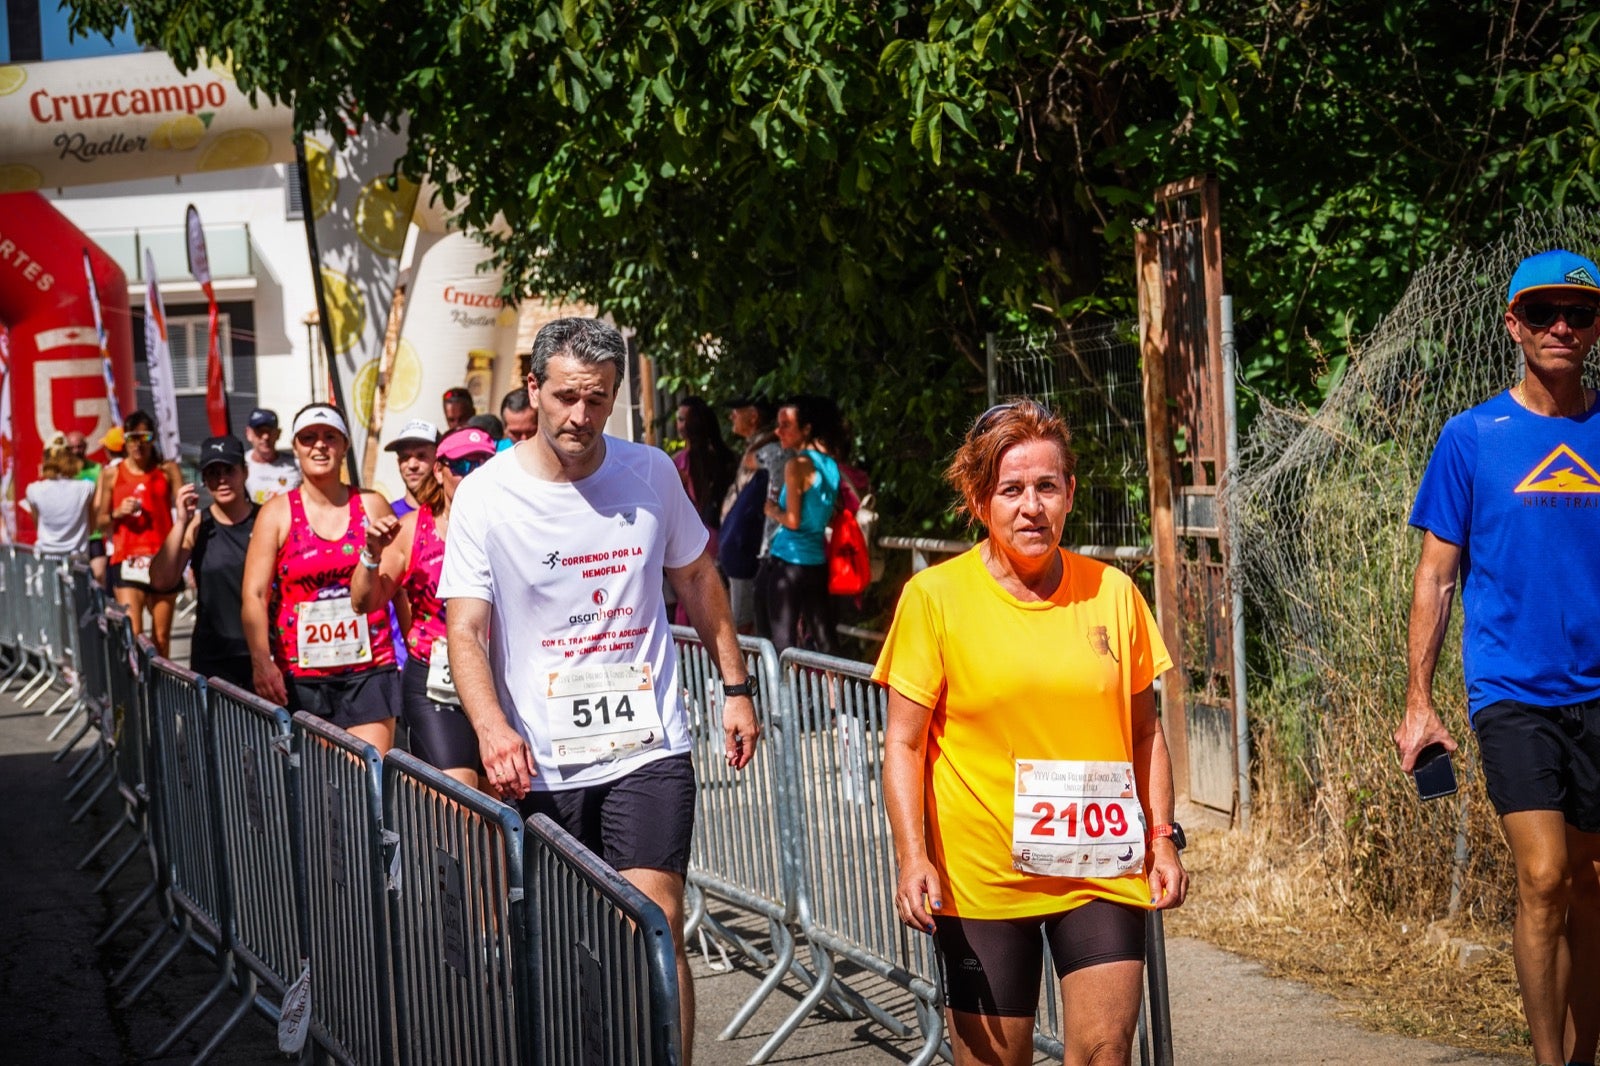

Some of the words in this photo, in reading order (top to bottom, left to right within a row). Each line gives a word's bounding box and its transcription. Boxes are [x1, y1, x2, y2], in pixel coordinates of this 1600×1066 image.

[29, 81, 227, 124] Cruzcampo
[53, 131, 149, 163] Radler
[0, 231, 55, 292] RTES
[444, 286, 503, 309] Cruzca
[1523, 496, 1557, 508] NIKE
[1565, 496, 1599, 508] TRAI
[561, 552, 610, 567] CORRIENDO
[612, 548, 629, 559] POR
[632, 547, 643, 556] LA
[582, 564, 627, 579] HEMOFILIA
[569, 606, 633, 624] asanhemo
[305, 619, 360, 644] 2041
[541, 639, 556, 648] CON
[564, 650, 575, 658] NO
[573, 694, 635, 728] 514
[1030, 801, 1129, 838] 2109
